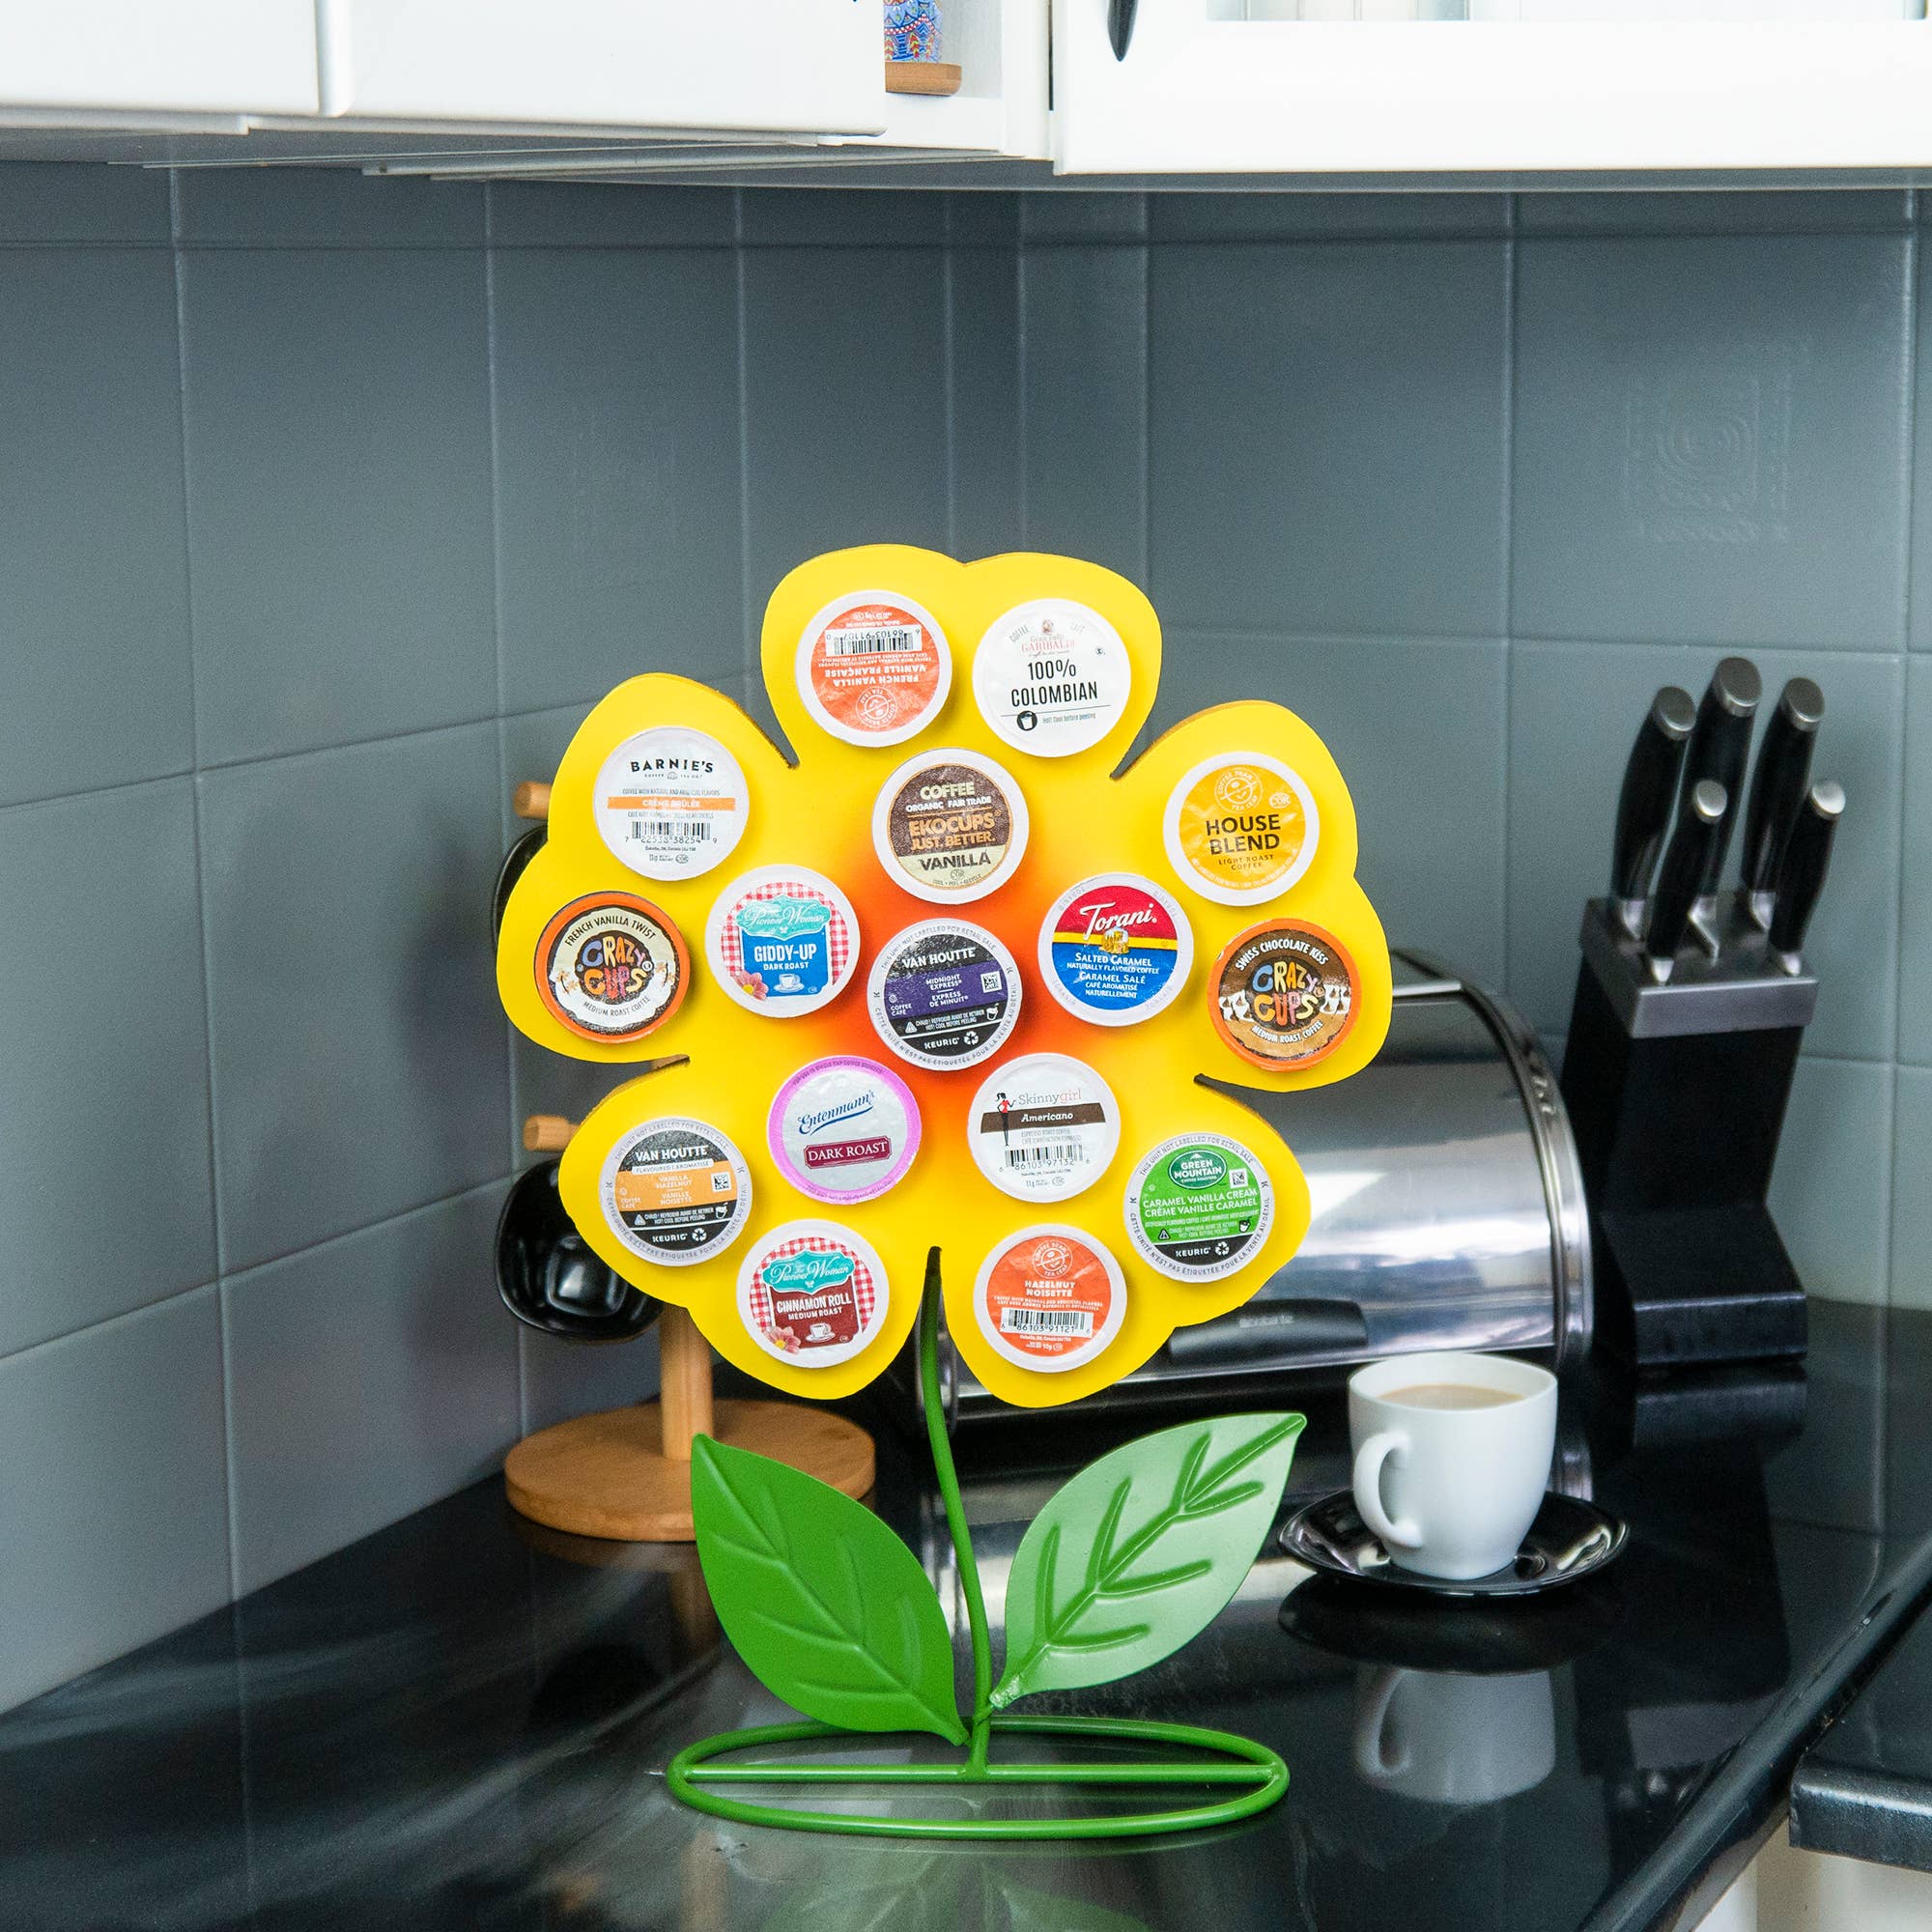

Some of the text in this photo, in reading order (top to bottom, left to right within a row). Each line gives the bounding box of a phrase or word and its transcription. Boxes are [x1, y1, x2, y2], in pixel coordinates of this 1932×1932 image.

[825, 665, 926, 677] VANILLE FRANÇAISE
[1028, 659, 1076, 680] 100%
[834, 674, 919, 687] FRENCH VANILLA
[1010, 681, 1097, 707] COLOMBIAN
[630, 758, 714, 773] BARNIE'S
[920, 781, 975, 800] COFFEE
[906, 796, 991, 811] ORGANIC FAIR TRADE
[1206, 814, 1281, 836] HOUSE
[1209, 834, 1280, 855] BLEND
[919, 852, 991, 871] VANILLA
[782, 904, 824, 925] Woman
[564, 916, 656, 947] FRENCH VANILLA TWIST
[582, 935, 645, 967] CRAZY
[753, 944, 817, 962] GIDDY-UP
[902, 948, 976, 968] VAN HOUTTE
[1075, 952, 1151, 966] SALTED CARAMEL
[1236, 938, 1329, 971] SWISS CHOCOLATE KISS
[1066, 962, 1102, 971] NATURALLY
[583, 966, 647, 1000] CUPS
[925, 974, 960, 984] MIDNIGHT
[1080, 971, 1146, 984] CARAMEL SALÉ
[1252, 961, 1319, 993] CRAZY
[932, 991, 961, 1001] EXPRESS
[1085, 989, 1138, 999] NATURELLEMENT
[583, 1001, 608, 1016] MEDIUM
[631, 996, 651, 1012] COFFEE
[1254, 991, 1319, 1026] CUPS
[1252, 1020, 1323, 1043] MEDIUM ROAST COFFEE
[1018, 1088, 1082, 1105] Skinnygirl
[798, 1090, 875, 1135] Entenmann's
[1021, 1113, 1073, 1122] Americano
[635, 1145, 708, 1161] VAN HOUTTE
[809, 1142, 885, 1161] DARK ROAST
[1140, 1163, 1151, 1177] THIS
[1161, 1144, 1175, 1152] NOT
[1176, 1137, 1207, 1148] LABELLED
[1174, 1167, 1222, 1179] MOUNTAIN
[1180, 1159, 1213, 1169] GREEN
[655, 1180, 693, 1189] HAZELNUT
[660, 1197, 693, 1206] NOISETTE
[1143, 1188, 1258, 1208] CARAMEL VANILLA CREAM
[1145, 1198, 1258, 1217] CRÈME VANILLE CARAMEL
[1130, 1212, 1139, 1232] CETTE
[1151, 1252, 1168, 1265] N'EST
[1221, 1260, 1237, 1270] POUR
[1238, 1252, 1246, 1261] LA
[1246, 1234, 1262, 1252] VENTE
[1260, 1221, 1265, 1232] AU
[807, 1256, 848, 1279] Woman
[1025, 1280, 1075, 1289] HAZELNUT
[777, 1293, 852, 1314] CINNAMON ROLL
[788, 1306, 842, 1320] MEDIUM ROAST
